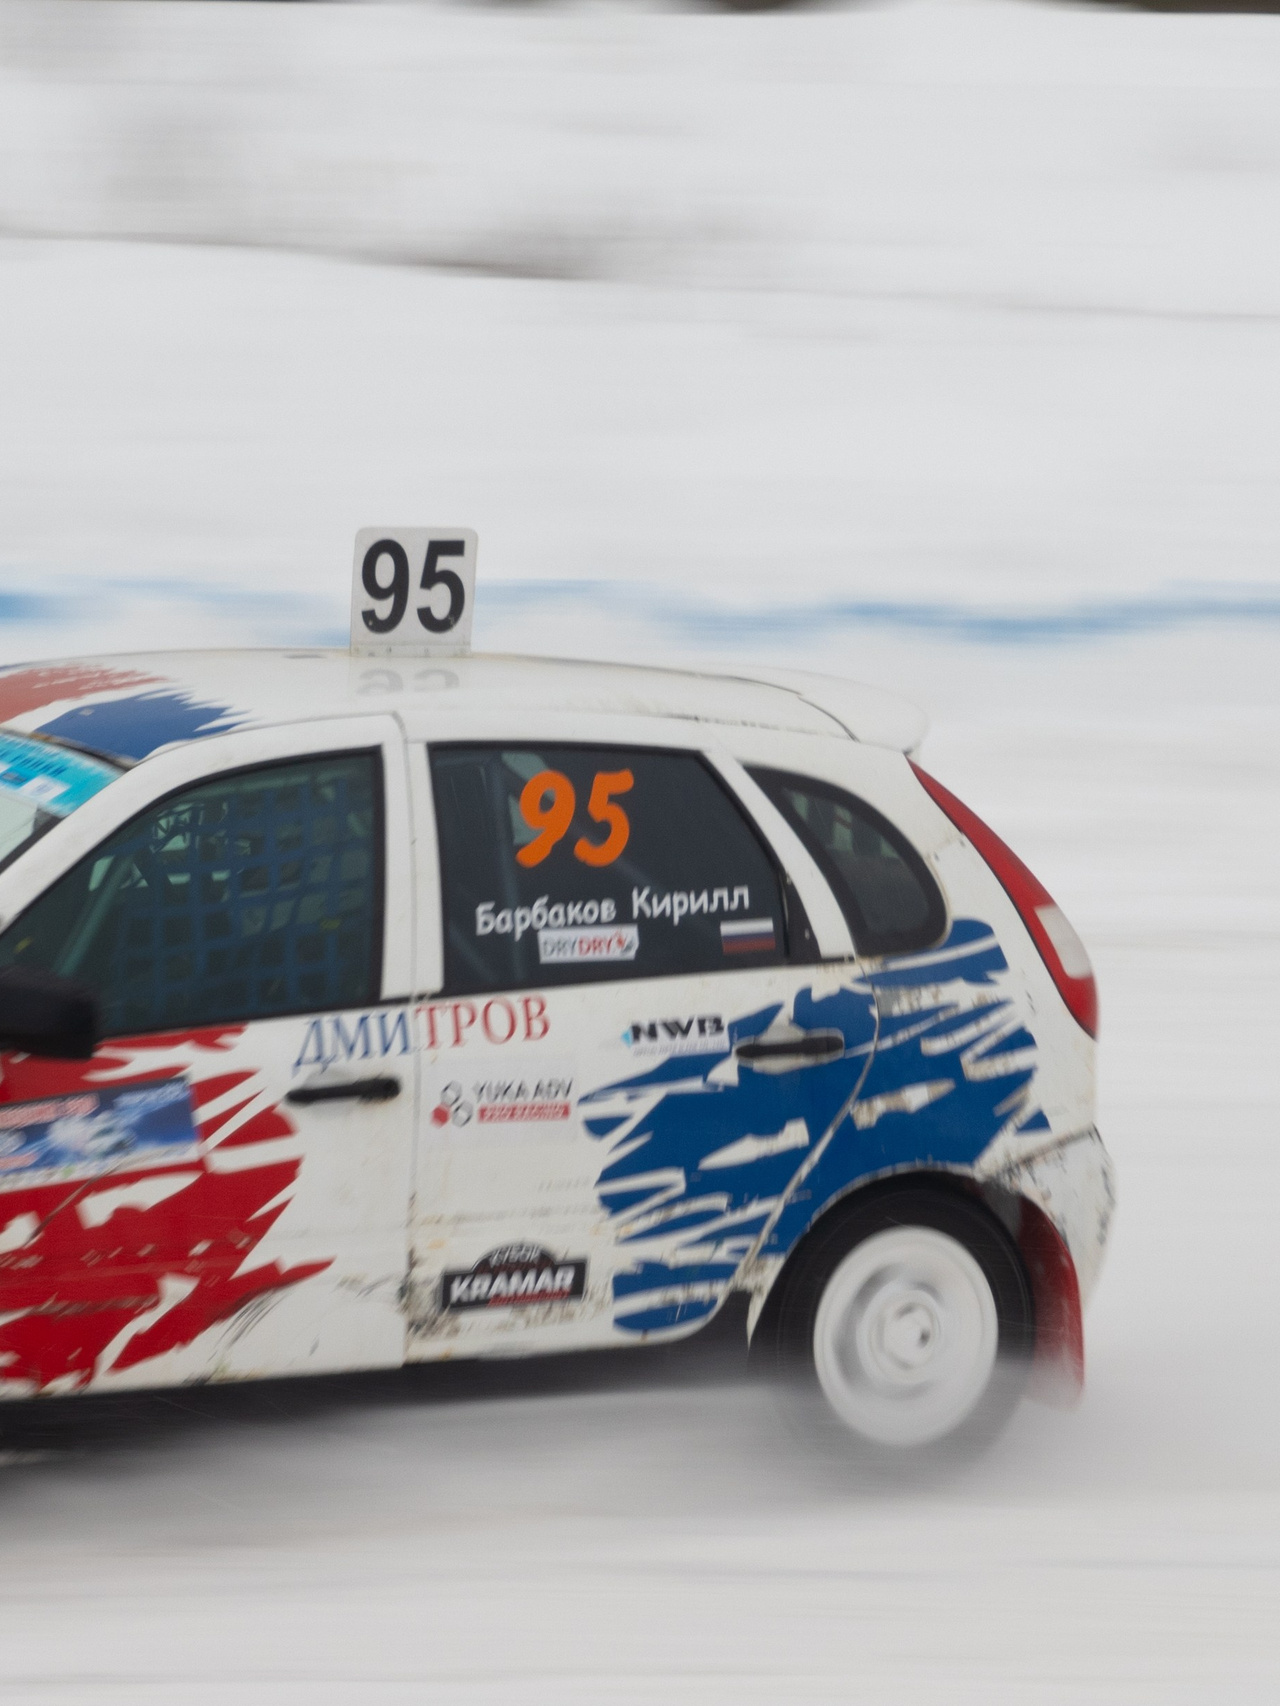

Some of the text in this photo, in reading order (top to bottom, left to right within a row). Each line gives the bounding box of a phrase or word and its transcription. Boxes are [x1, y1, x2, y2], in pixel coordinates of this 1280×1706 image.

[361, 538, 465, 634] 95
[515, 768, 634, 868] 95
[475, 885, 749, 941] Барбаков Кирилл
[291, 992, 551, 1079] ДМИТРОВ
[630, 1015, 725, 1043] NWB
[450, 1265, 576, 1304] KRAMAR
